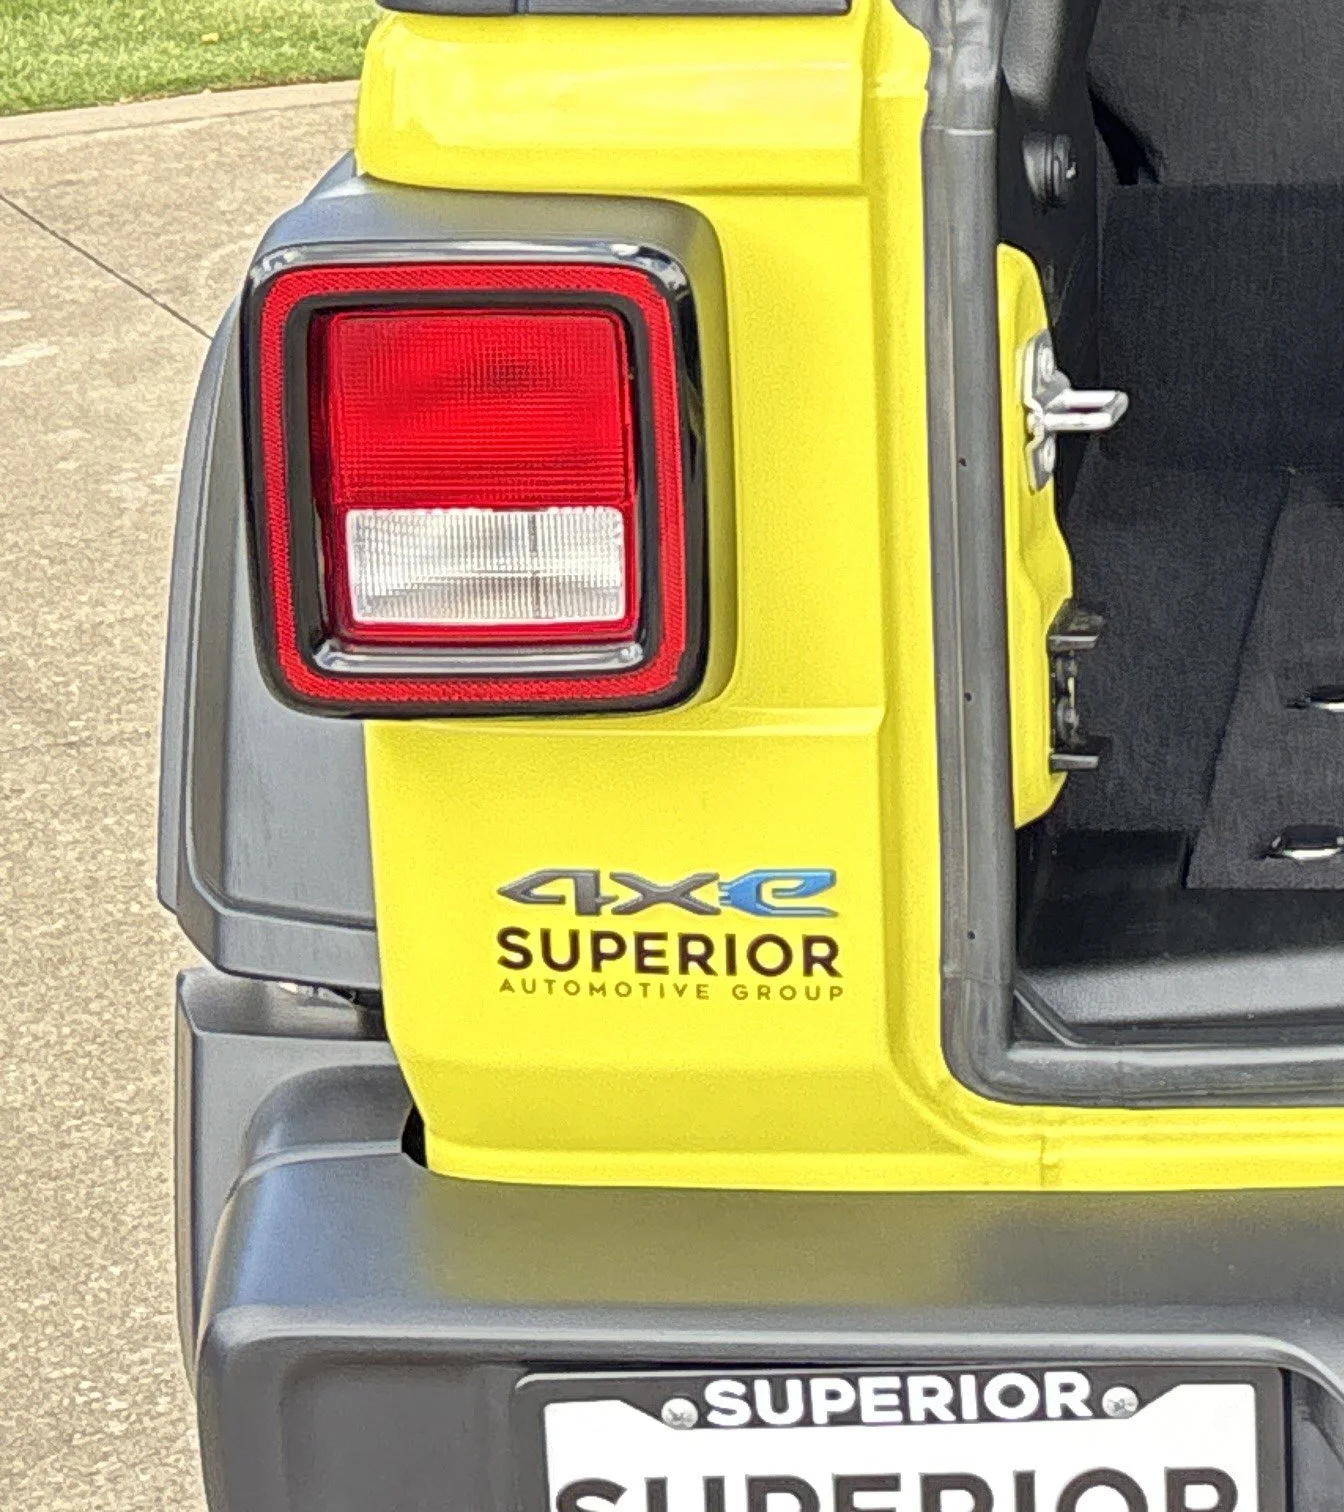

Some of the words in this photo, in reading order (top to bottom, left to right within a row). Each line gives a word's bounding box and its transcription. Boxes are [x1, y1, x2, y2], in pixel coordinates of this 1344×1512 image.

[496, 926, 844, 978] SUPERIOR
[498, 977, 710, 1000] AUTOMOTIVE
[731, 984, 844, 1001] GROUP
[703, 1370, 1094, 1427] SUPERIOR
